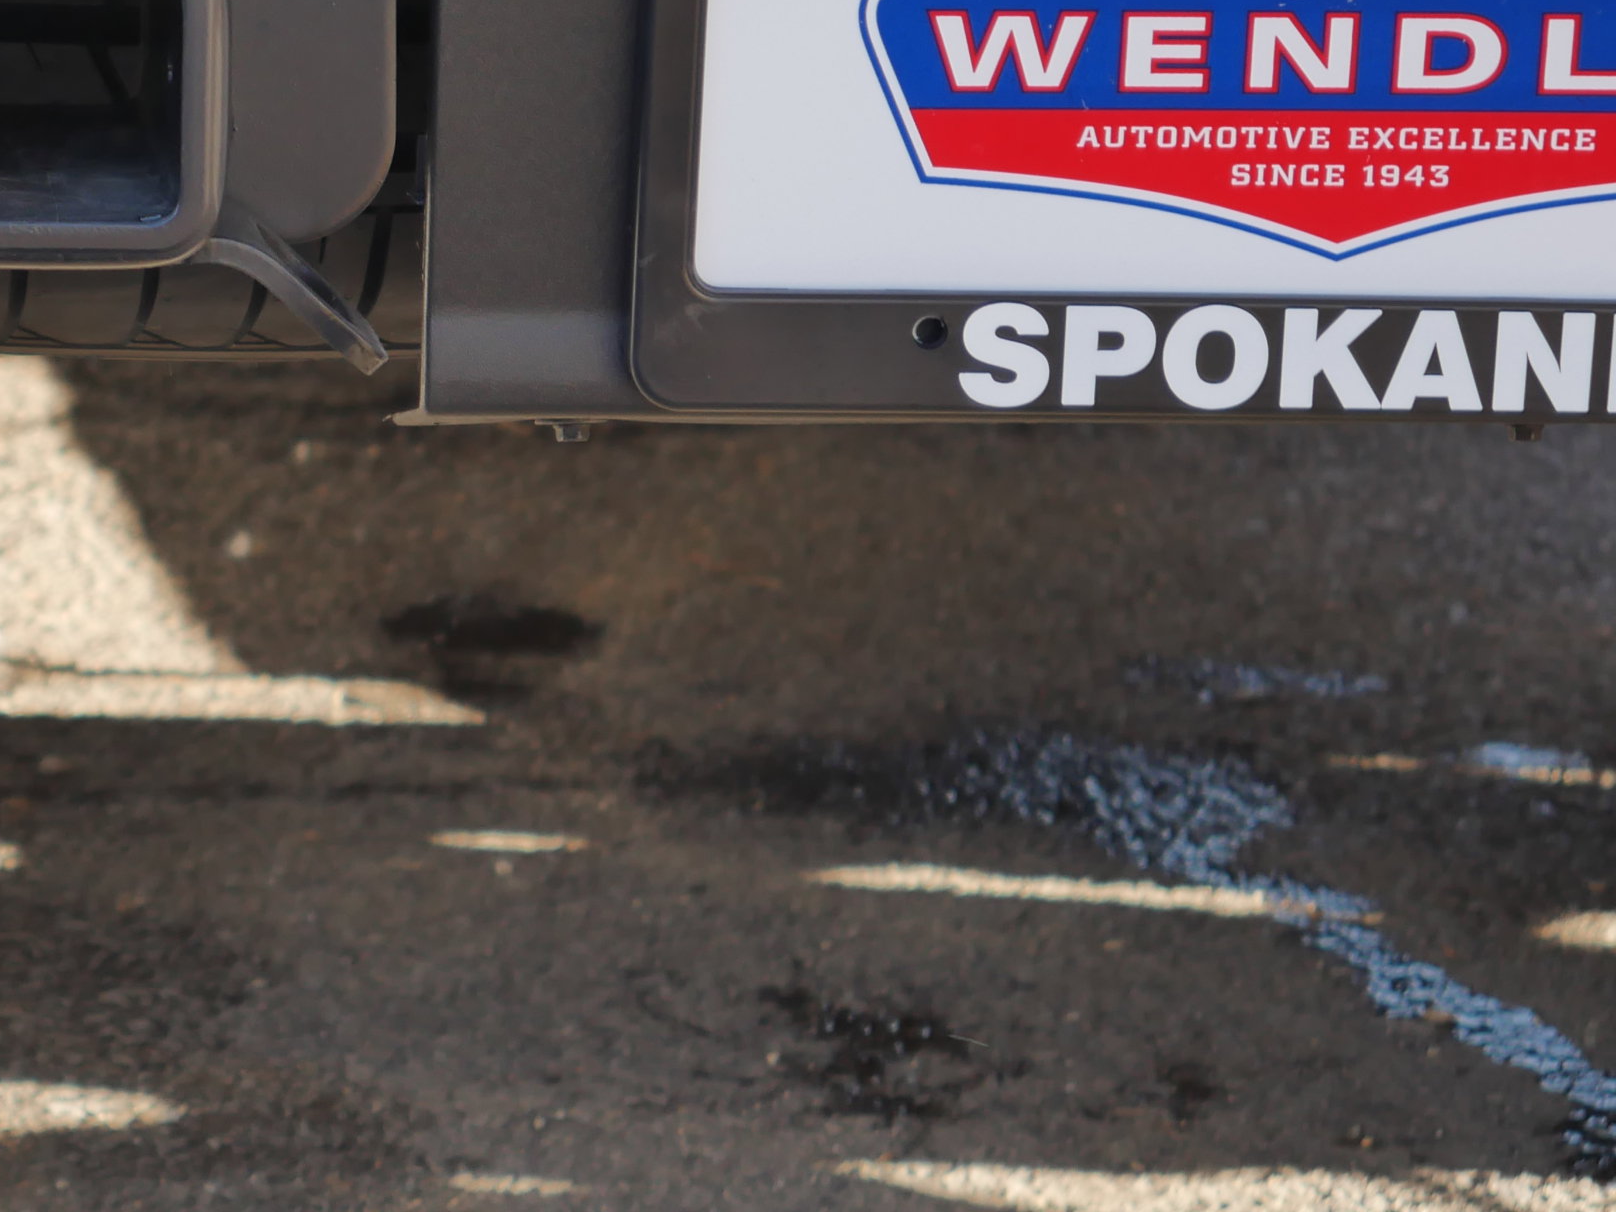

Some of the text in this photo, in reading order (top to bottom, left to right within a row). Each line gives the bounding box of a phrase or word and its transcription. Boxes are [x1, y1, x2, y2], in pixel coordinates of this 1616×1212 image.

[927, 10, 1616, 94] WENDL
[1077, 125, 1596, 151] AUTOMOTIVE EXCELLENCE
[1230, 163, 1450, 187] SINCE 1943
[958, 301, 1616, 414] SPOKAN
